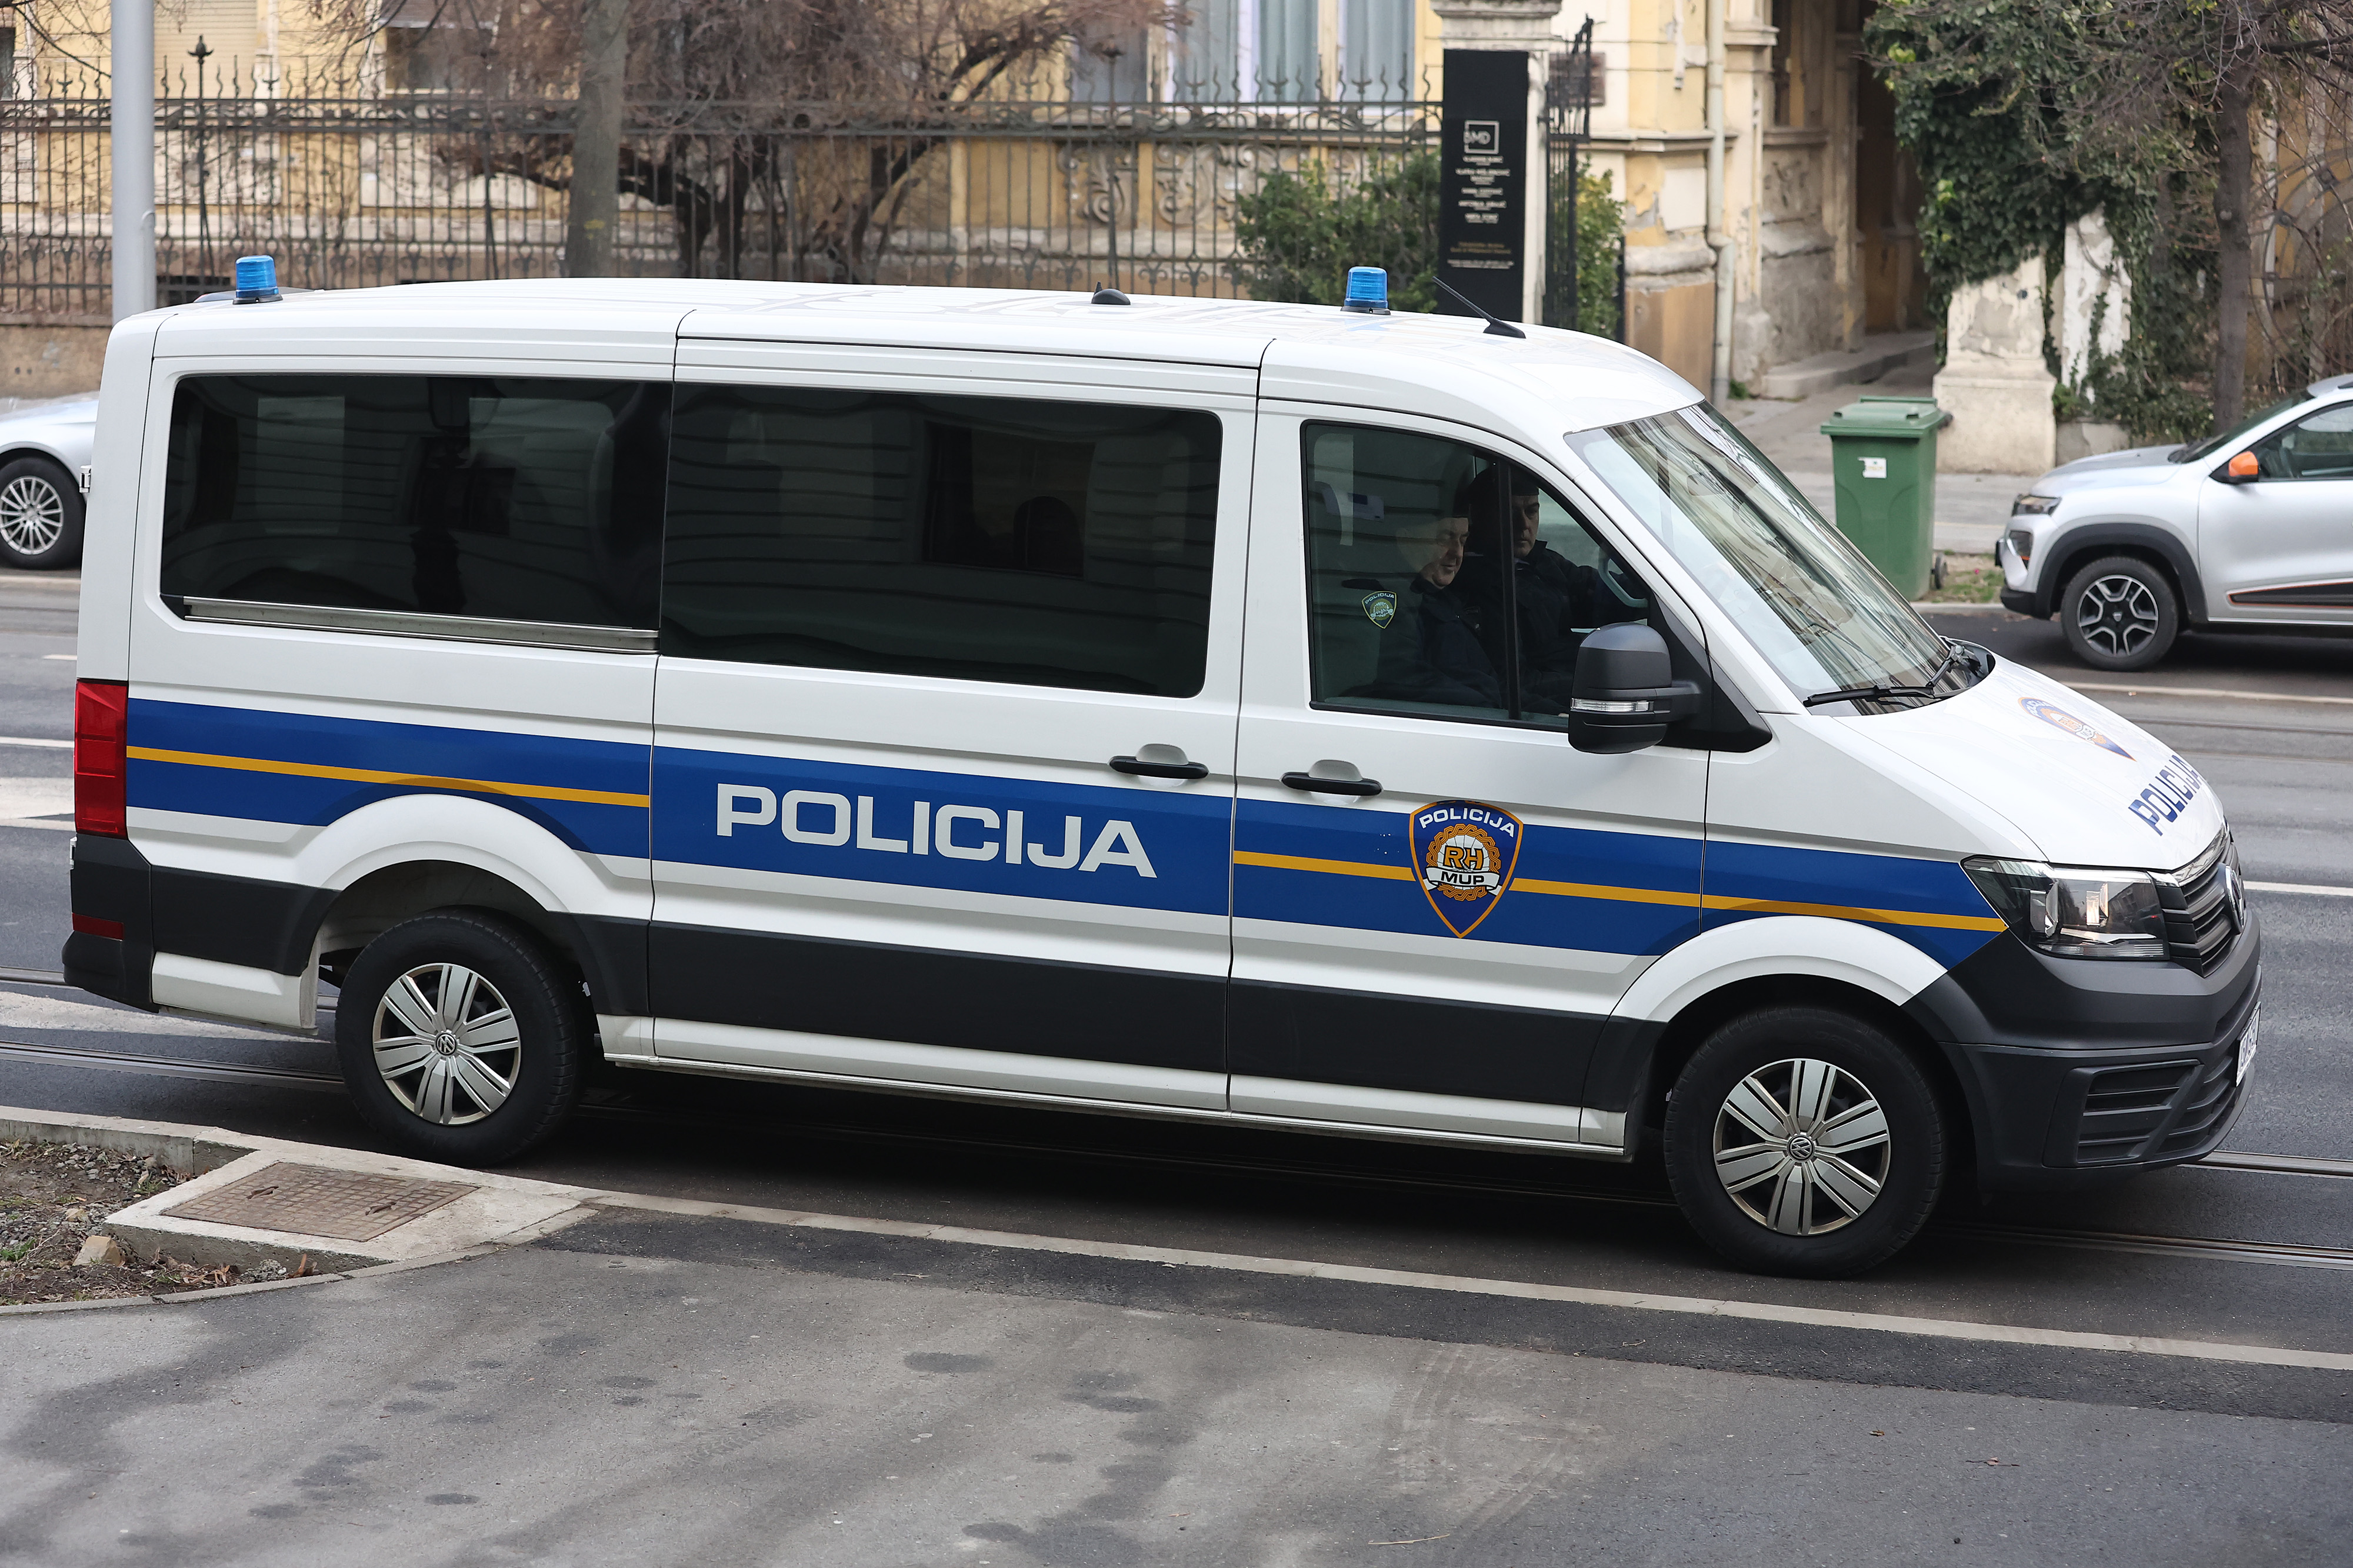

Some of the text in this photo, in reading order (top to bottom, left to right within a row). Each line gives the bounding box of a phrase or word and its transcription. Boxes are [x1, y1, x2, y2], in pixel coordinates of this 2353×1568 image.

[1365, 593, 1394, 604] POLICIJA
[2128, 755, 2202, 836] POLICIJA
[716, 783, 1158, 878] POLICIJA
[1419, 808, 1515, 838] POLICIJA
[1443, 845, 1484, 870] RH
[1441, 871, 1485, 885] MUP
